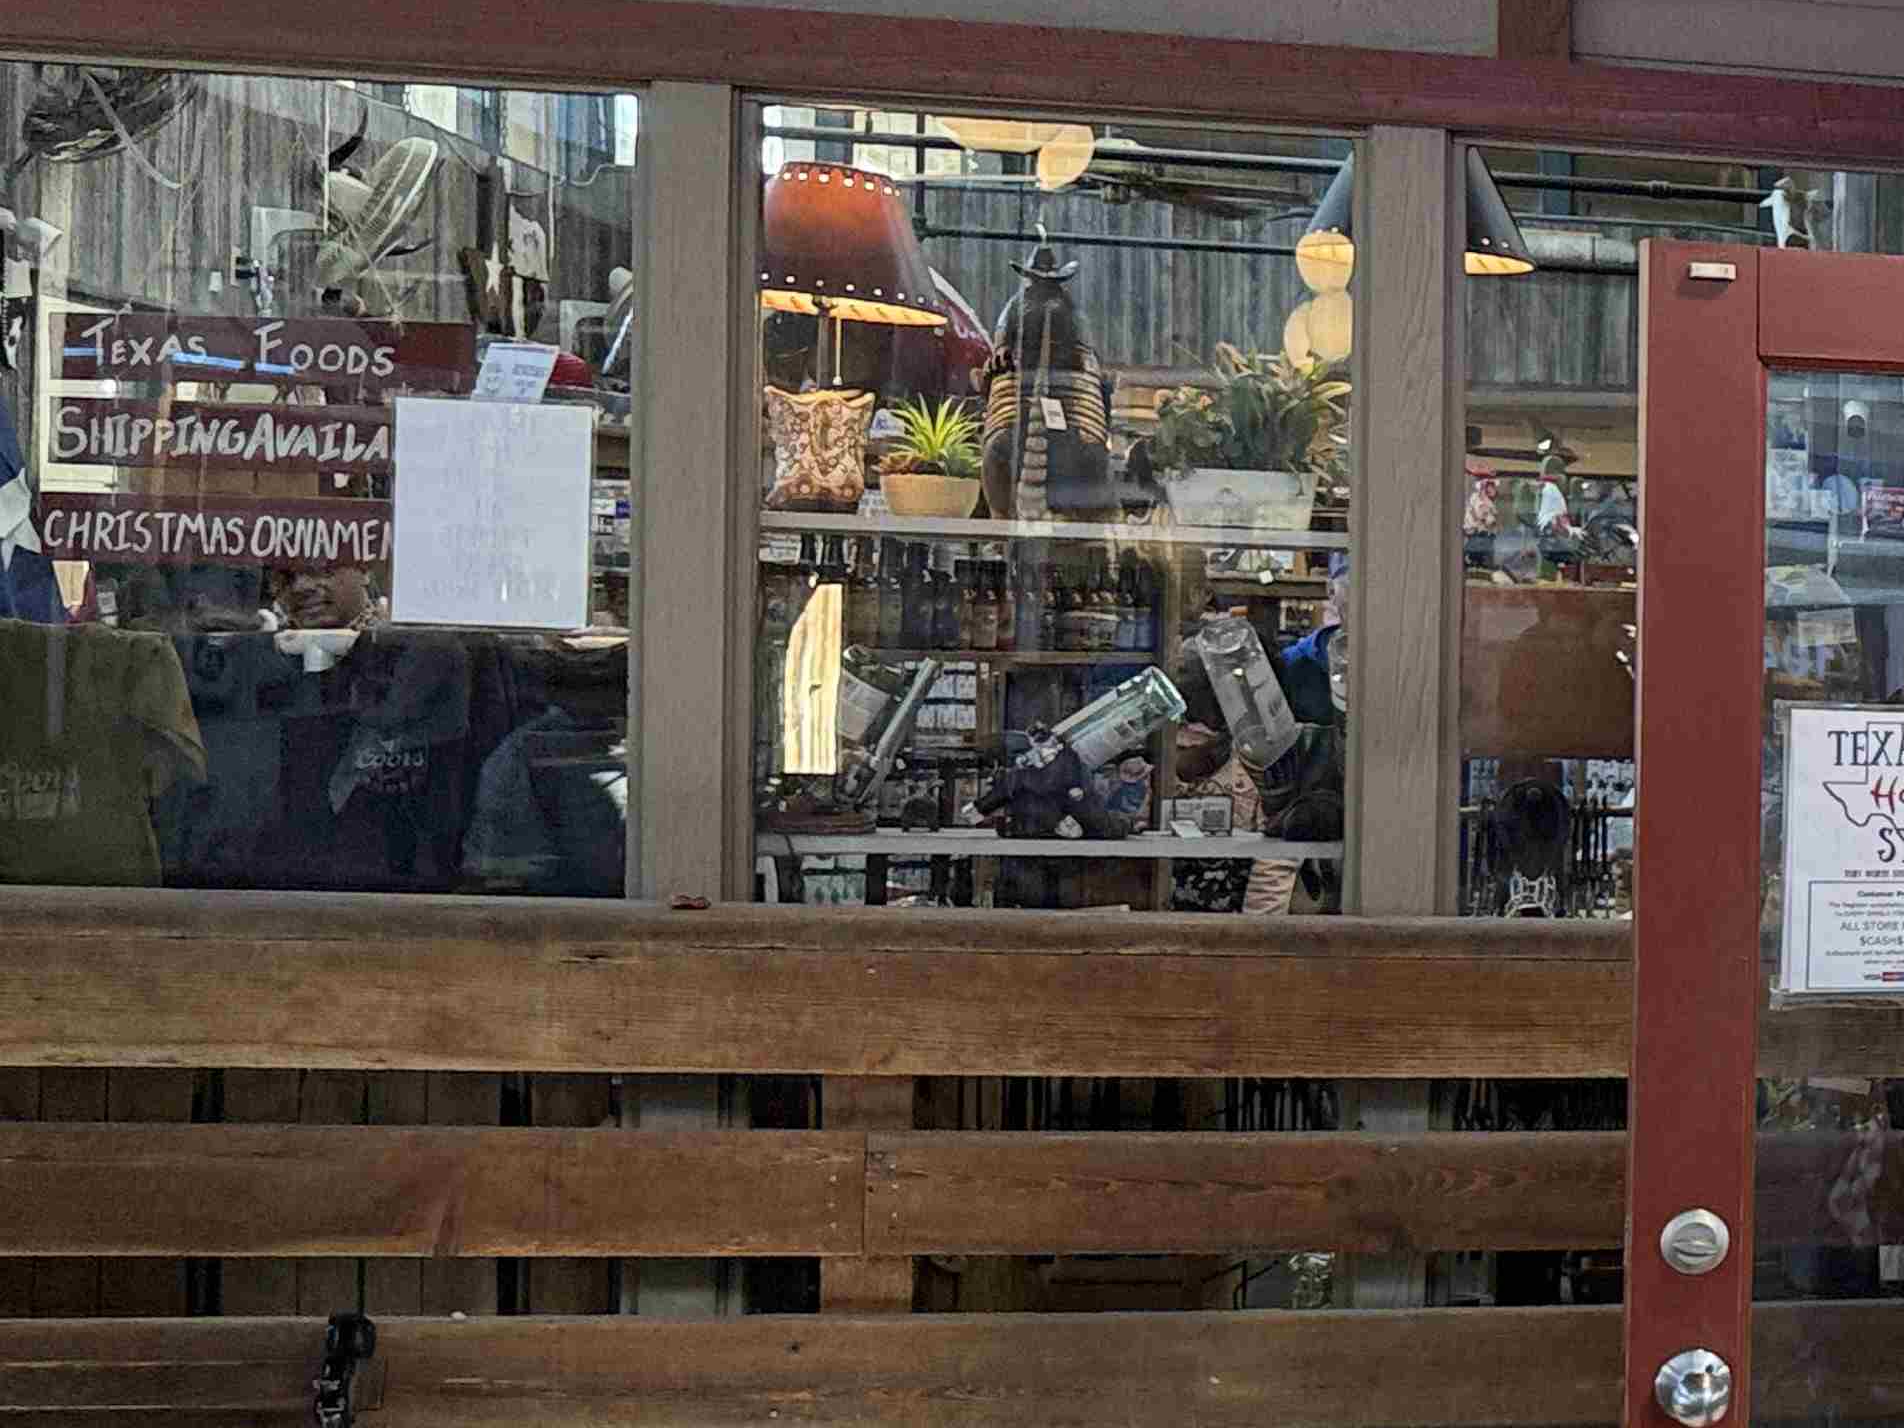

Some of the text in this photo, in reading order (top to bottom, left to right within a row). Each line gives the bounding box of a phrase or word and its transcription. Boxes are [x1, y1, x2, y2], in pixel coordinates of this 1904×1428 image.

[43, 509, 245, 555] CHRISTMAS
[1840, 921, 1861, 931] ALL
[1863, 921, 1899, 931] STORE
